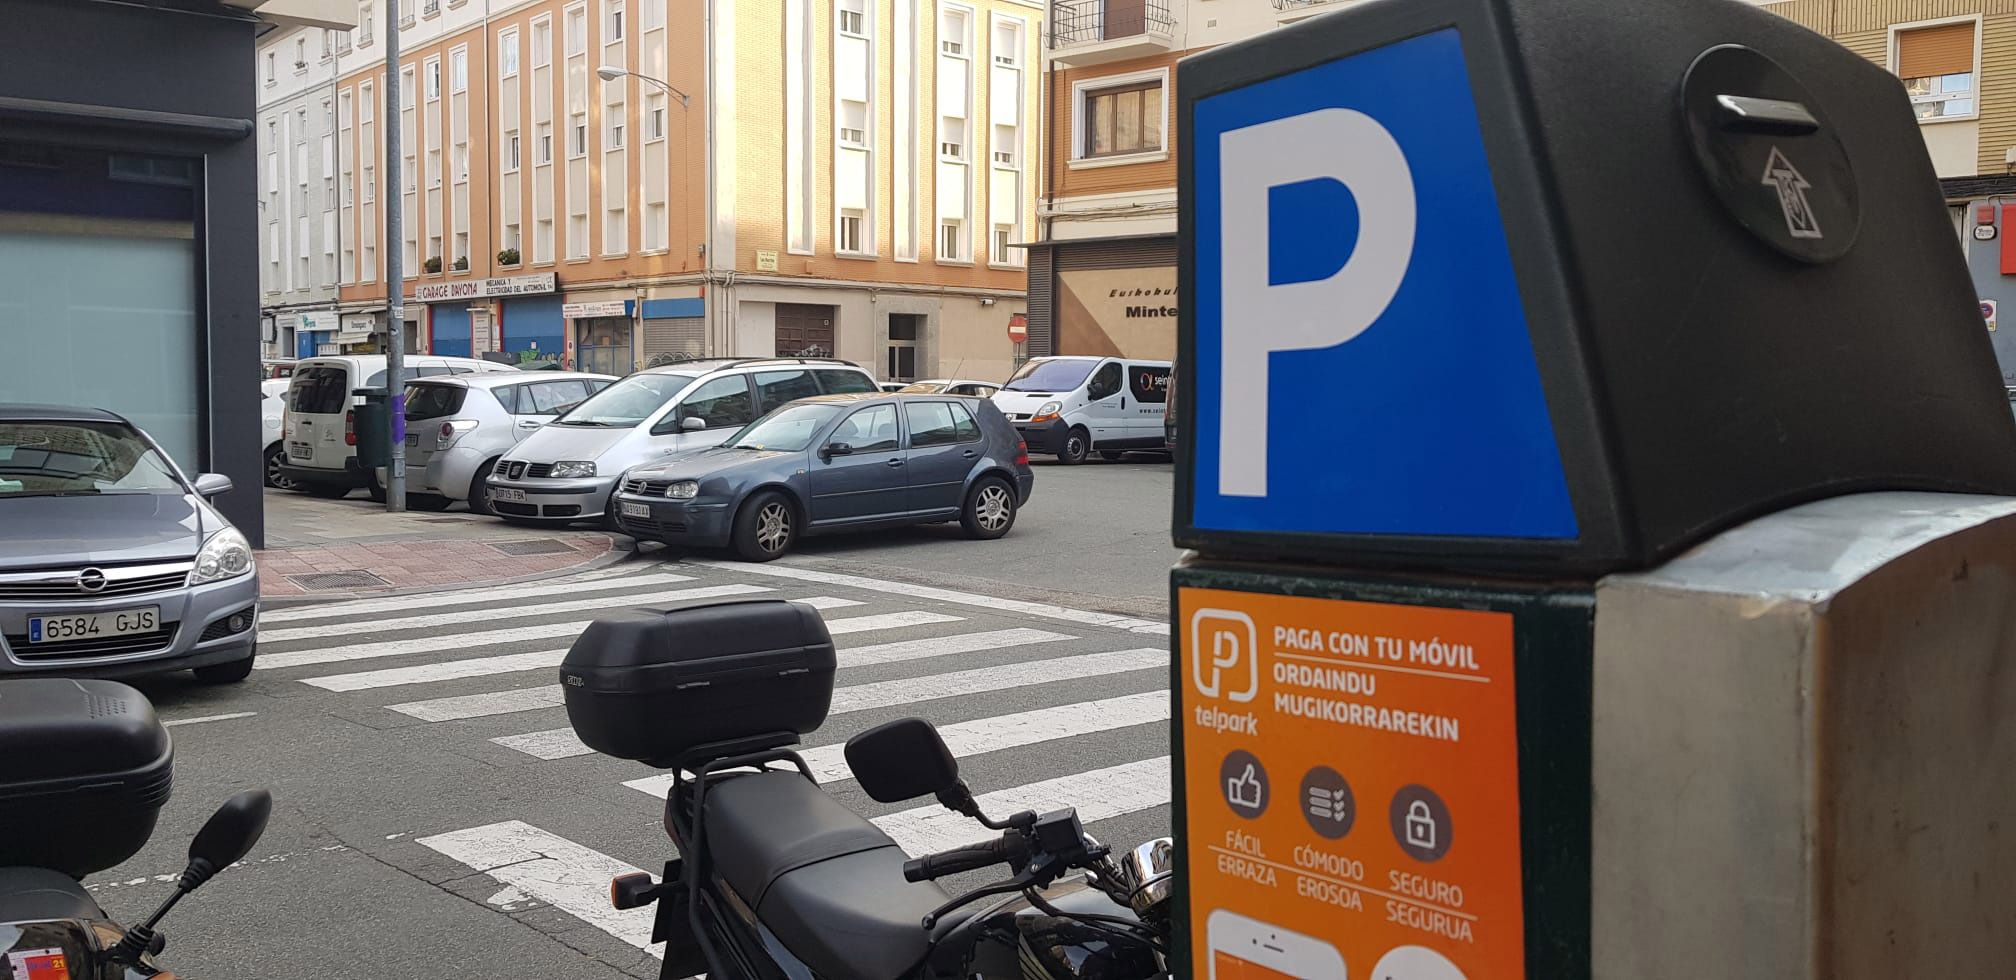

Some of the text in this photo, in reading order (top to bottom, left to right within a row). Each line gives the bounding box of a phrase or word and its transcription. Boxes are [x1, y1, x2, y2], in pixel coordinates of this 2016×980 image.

[422, 285, 449, 299] GARAGE
[1219, 107, 1416, 498] P
[47, 612, 153, 638] 6584 GJS
[1274, 625, 1480, 671] PAGA CON TU MÓVIL
[1273, 662, 1376, 696] ORDAINDU
[1195, 704, 1258, 736] telpark
[1274, 691, 1459, 742] MUGIKORRAREKIN
[1225, 829, 1266, 857] FÁCIL
[1217, 854, 1277, 887] ERRAZA
[1293, 844, 1364, 881] CÓMODO
[1297, 876, 1363, 912] EROSOA
[1389, 870, 1463, 907] SEGURO
[1386, 901, 1473, 943] SEGURUA
